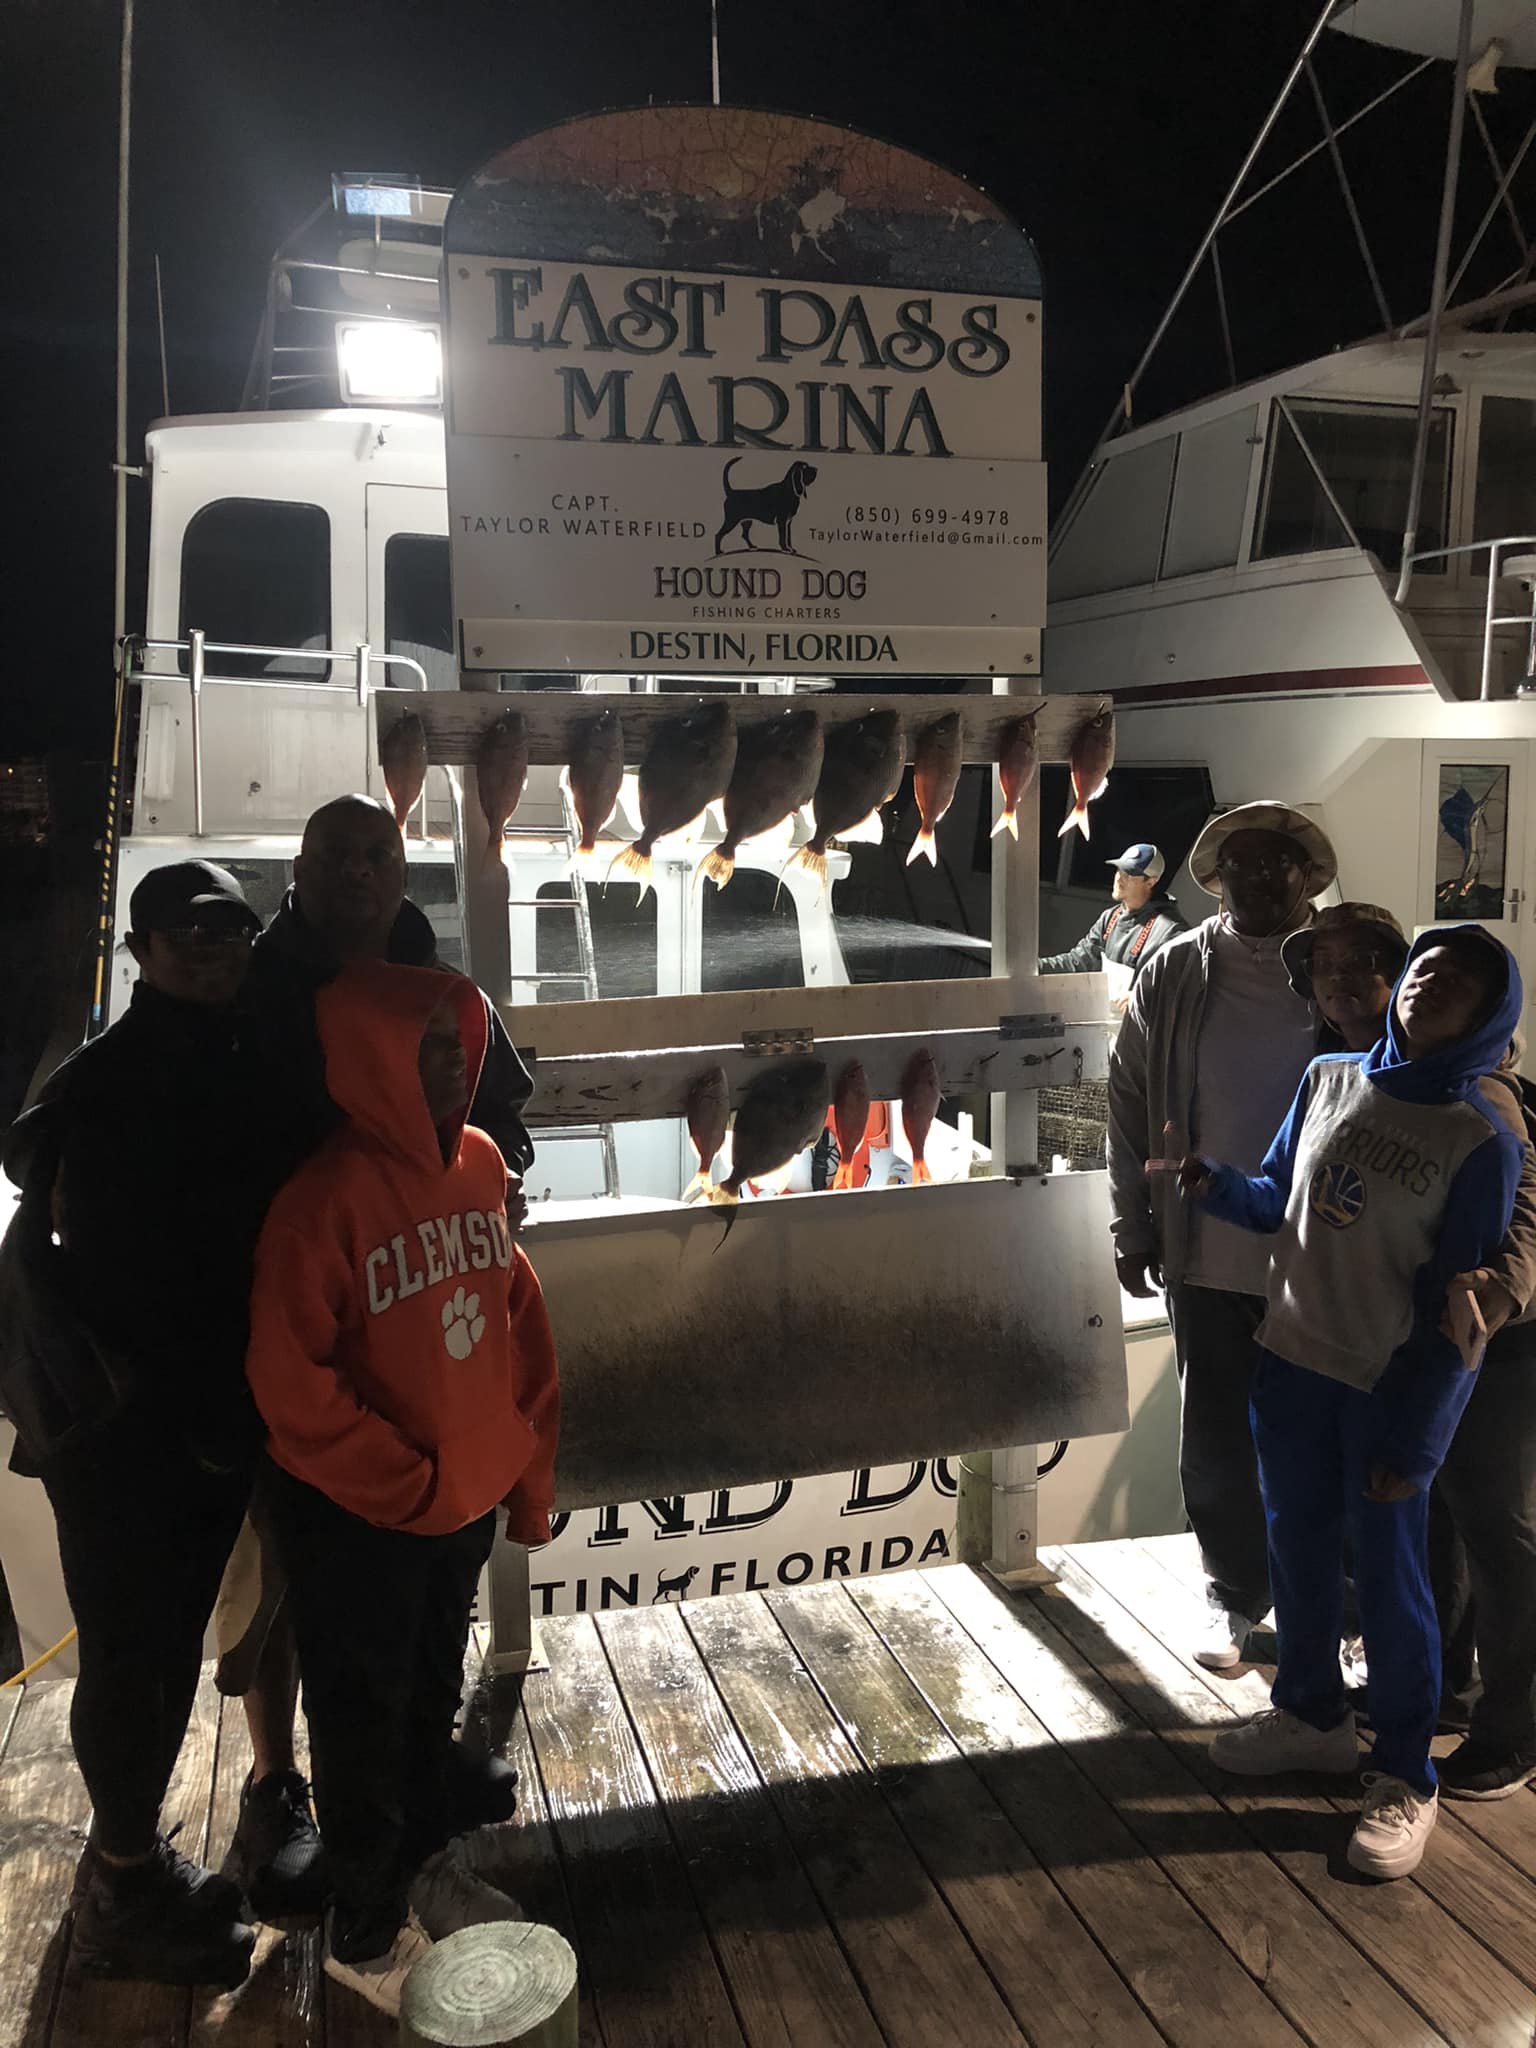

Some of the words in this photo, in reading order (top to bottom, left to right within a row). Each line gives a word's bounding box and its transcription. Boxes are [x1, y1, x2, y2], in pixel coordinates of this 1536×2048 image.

[486, 265, 725, 358] EAST
[756, 287, 1011, 378] PASS
[555, 366, 956, 458] MARINA
[551, 493, 620, 513] CAPT.
[845, 506, 900, 526] (850)
[911, 508, 1010, 527] 699-4978
[461, 515, 551, 535] TAYLOR
[562, 518, 706, 539] WATERFIELD
[808, 527, 1043, 546] TaylorWaterfield@Gmail.com
[653, 565, 782, 600] HOUND
[801, 568, 867, 602] DOG
[692, 606, 757, 619] FISHING
[764, 606, 842, 620] CHARTERS
[629, 630, 756, 668] DESTIN,
[765, 632, 899, 662] FLORIDA
[365, 1209, 514, 1315] CLEMSO
[710, 1527, 951, 1597] FLORIDA
